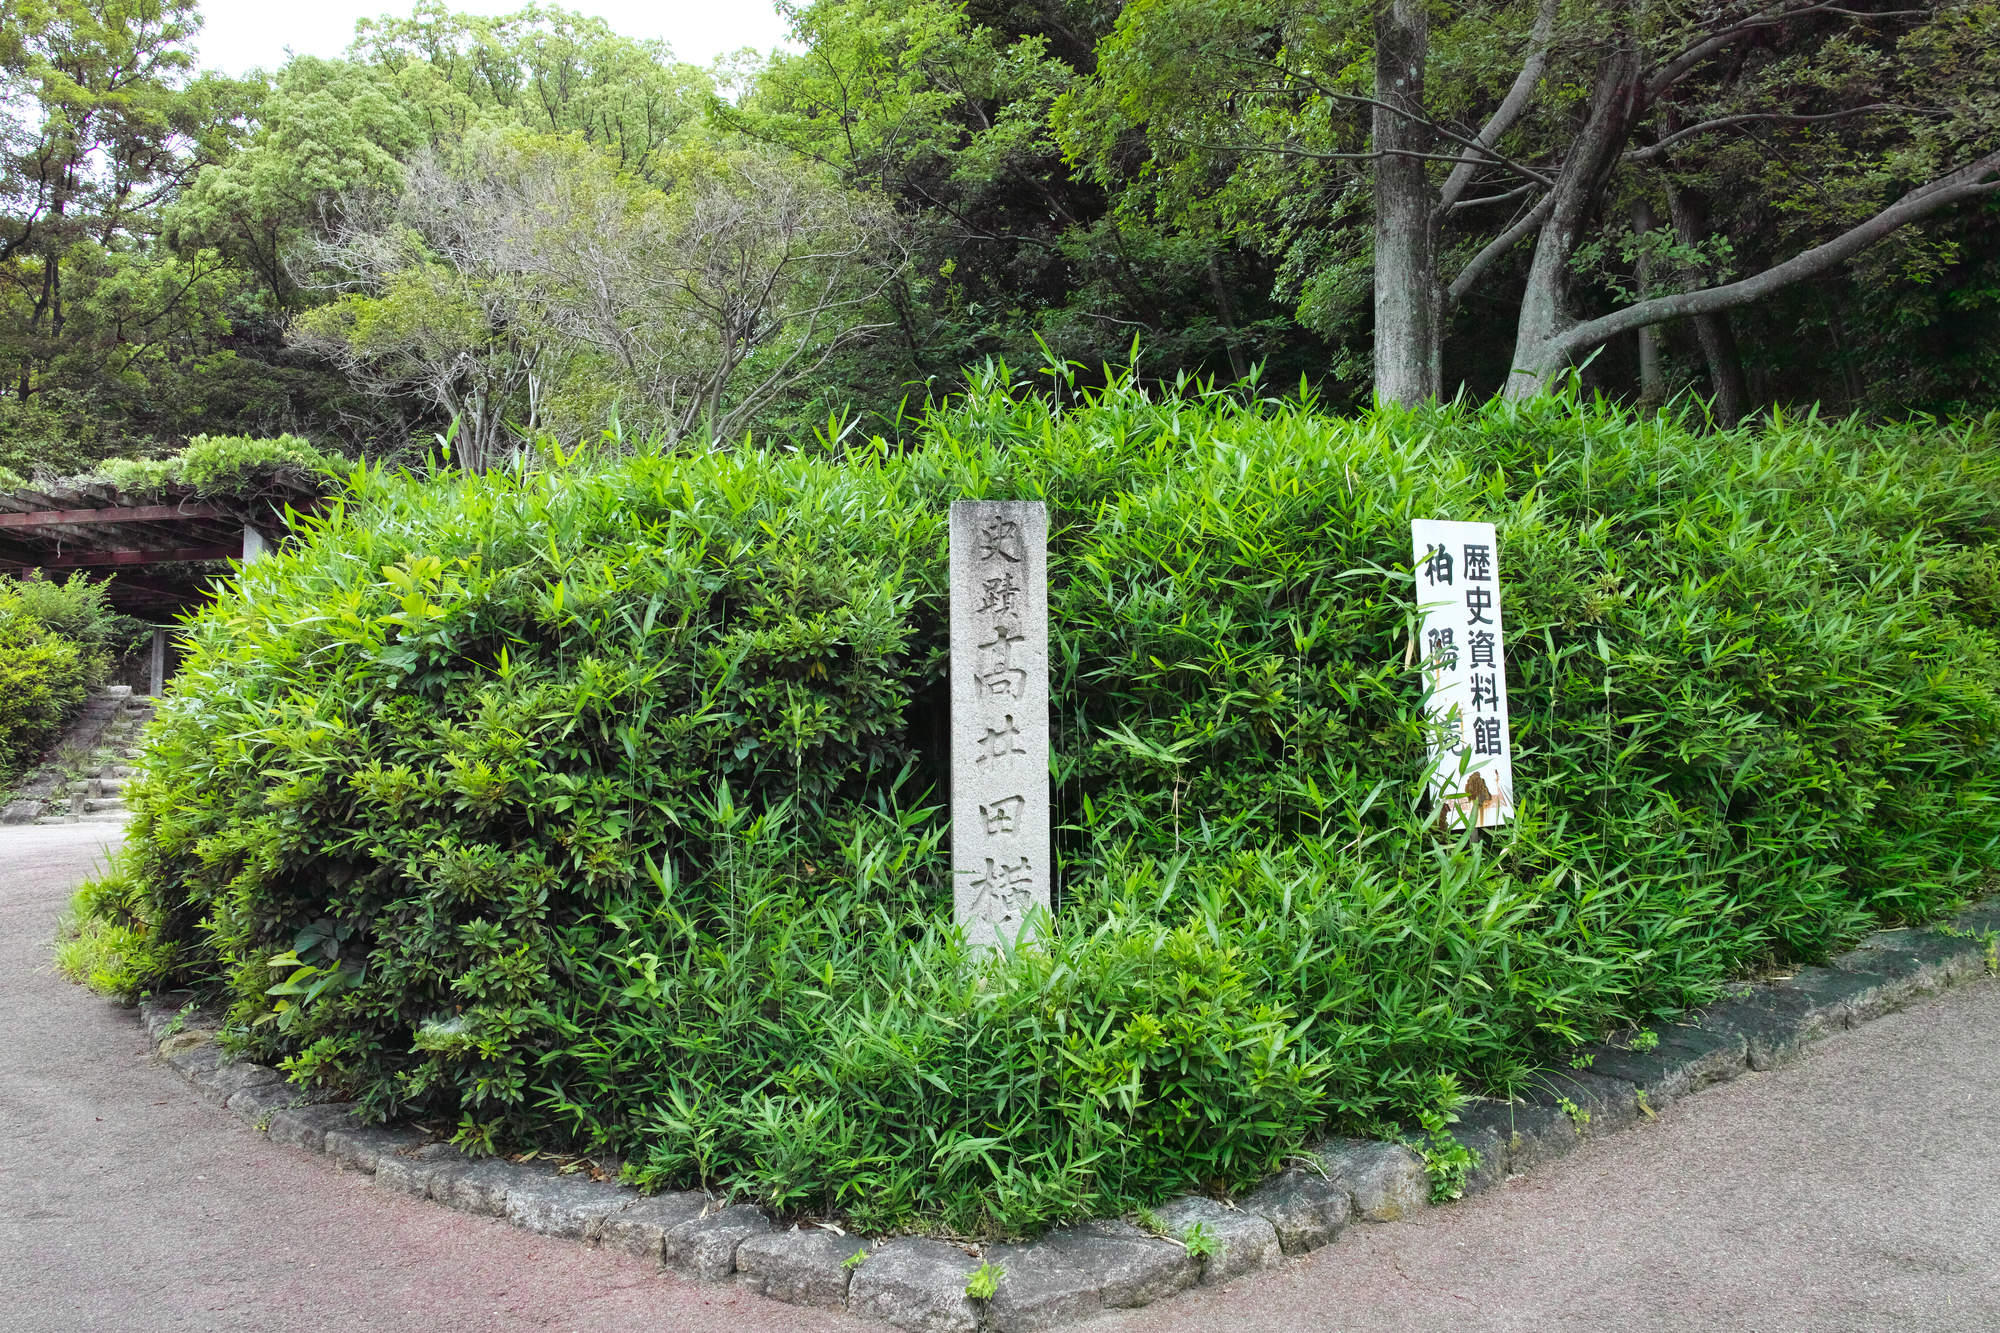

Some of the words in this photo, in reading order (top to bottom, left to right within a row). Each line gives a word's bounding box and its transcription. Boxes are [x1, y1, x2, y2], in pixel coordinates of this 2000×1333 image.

[1463, 543, 1502, 757] 歴史資料館
